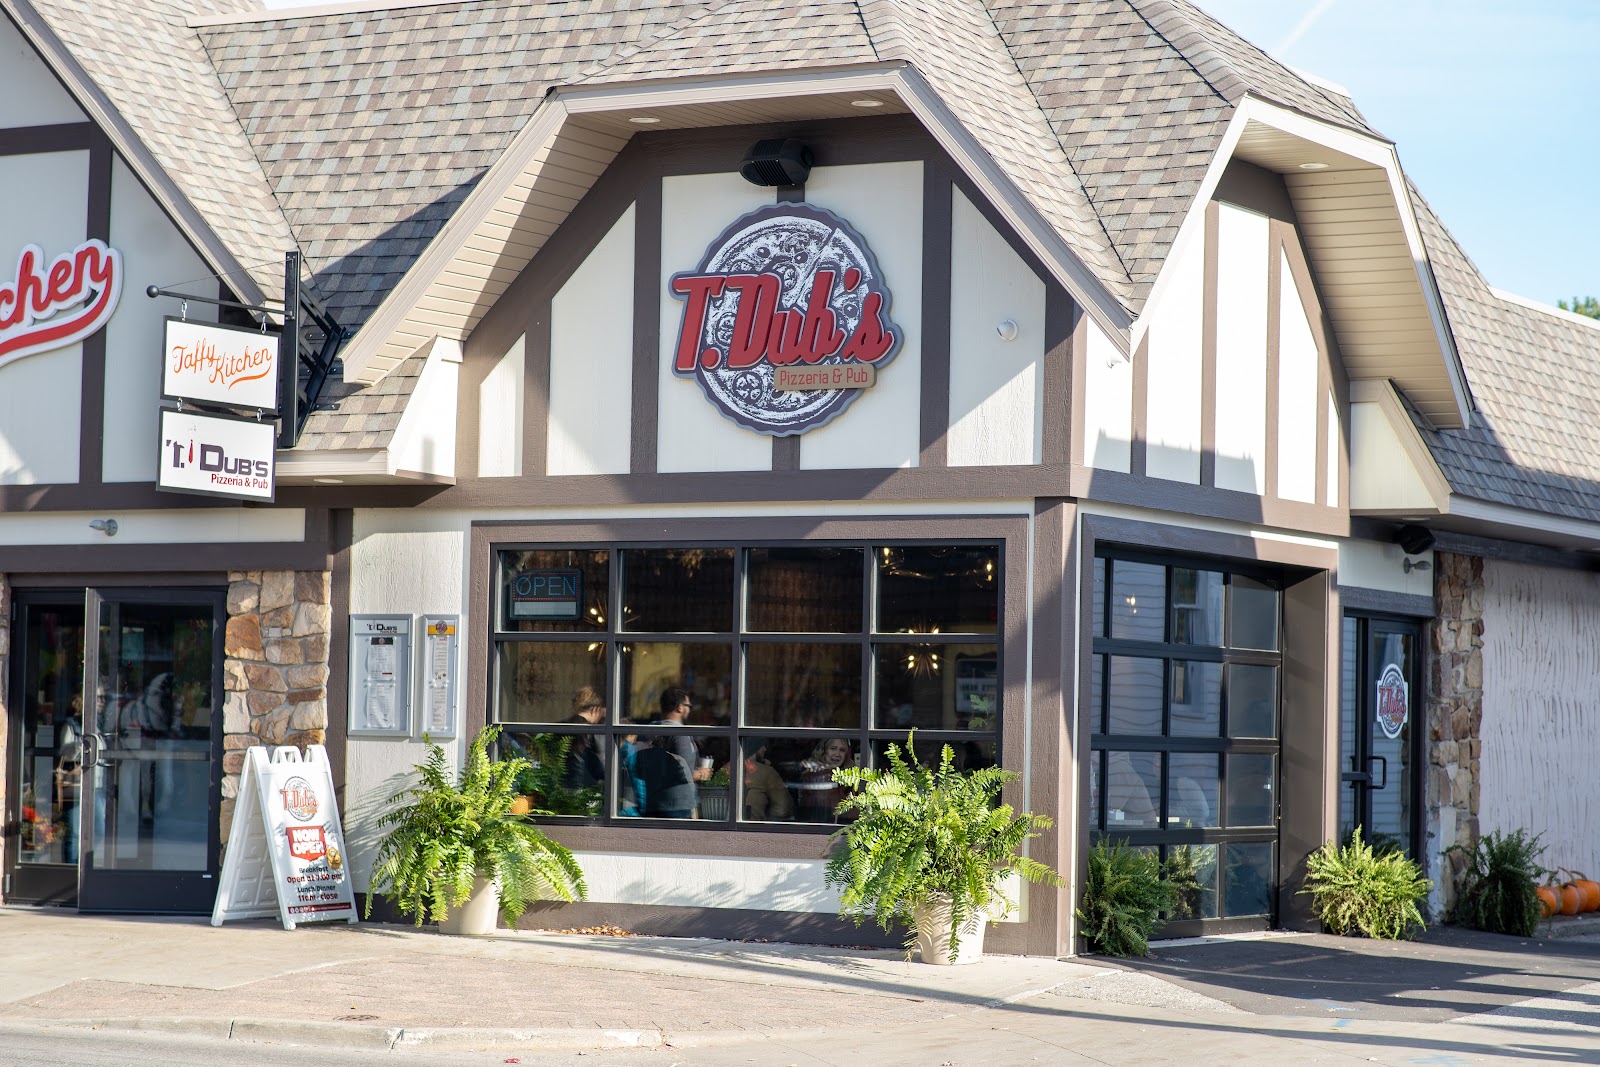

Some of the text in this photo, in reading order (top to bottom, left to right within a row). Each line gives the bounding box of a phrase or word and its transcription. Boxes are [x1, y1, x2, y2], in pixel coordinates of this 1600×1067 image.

[172, 338, 217, 374] Taffy
[209, 345, 272, 385] Kitchen
[779, 367, 868, 386] Pizzeria & Pub
[211, 473, 269, 489] Pizzeria & Pub
[515, 576, 577, 596] OPEN
[292, 828, 321, 842] NOW
[292, 841, 325, 855] OPEN
[286, 876, 305, 884] Open
[320, 893, 339, 901] close
